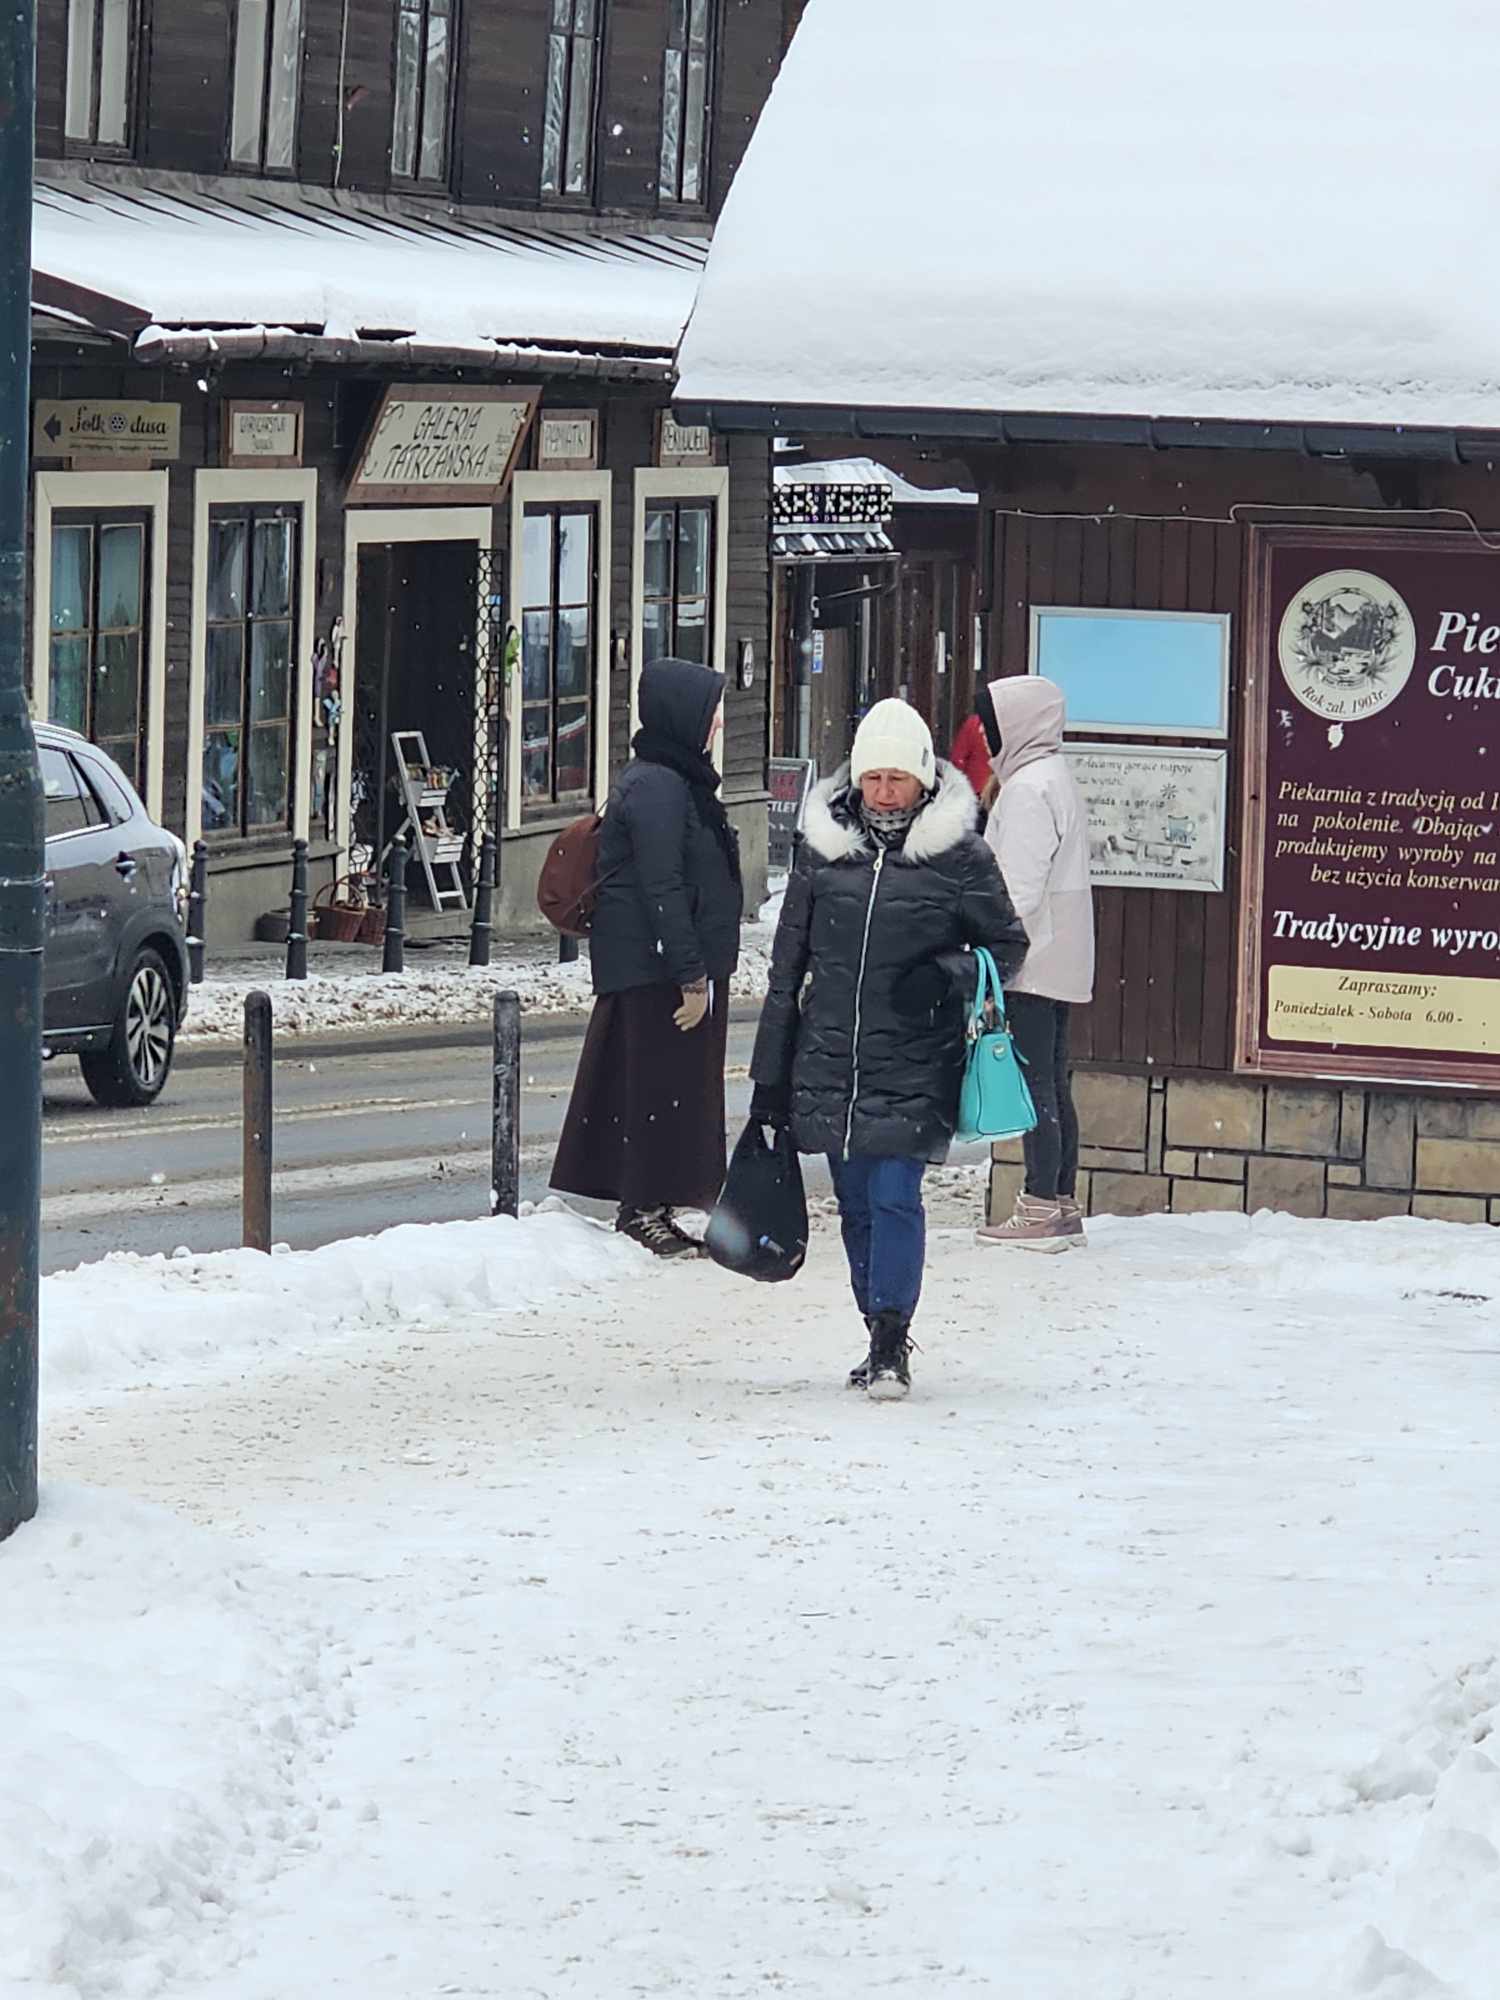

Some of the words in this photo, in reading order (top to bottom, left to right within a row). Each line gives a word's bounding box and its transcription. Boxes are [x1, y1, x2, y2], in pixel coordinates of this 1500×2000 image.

[413, 406, 484, 440] GALERIA
[1302, 686, 1324, 707] Rok
[767, 801, 797, 812] TLET
[1278, 781, 1361, 803] Piekarnia
[1366, 790, 1376, 806] z
[1381, 788, 1455, 814] tradycją
[1460, 792, 1485, 810] od
[1277, 812, 1299, 828] na
[1416, 816, 1484, 842] Dbając
[1275, 836, 1388, 863] produkujemy
[1399, 844, 1464, 867] wyroby
[1473, 850, 1496, 865] na
[1311, 864, 1340, 885] bez
[1345, 867, 1401, 889] użycia
[1273, 910, 1422, 950] Tradycyjne
[1430, 926, 1500, 955] wyro
[1338, 976, 1437, 999] Zapraszamy:
[1368, 1006, 1412, 1021] Sobota
[1426, 1010, 1453, 1023] 6.00
